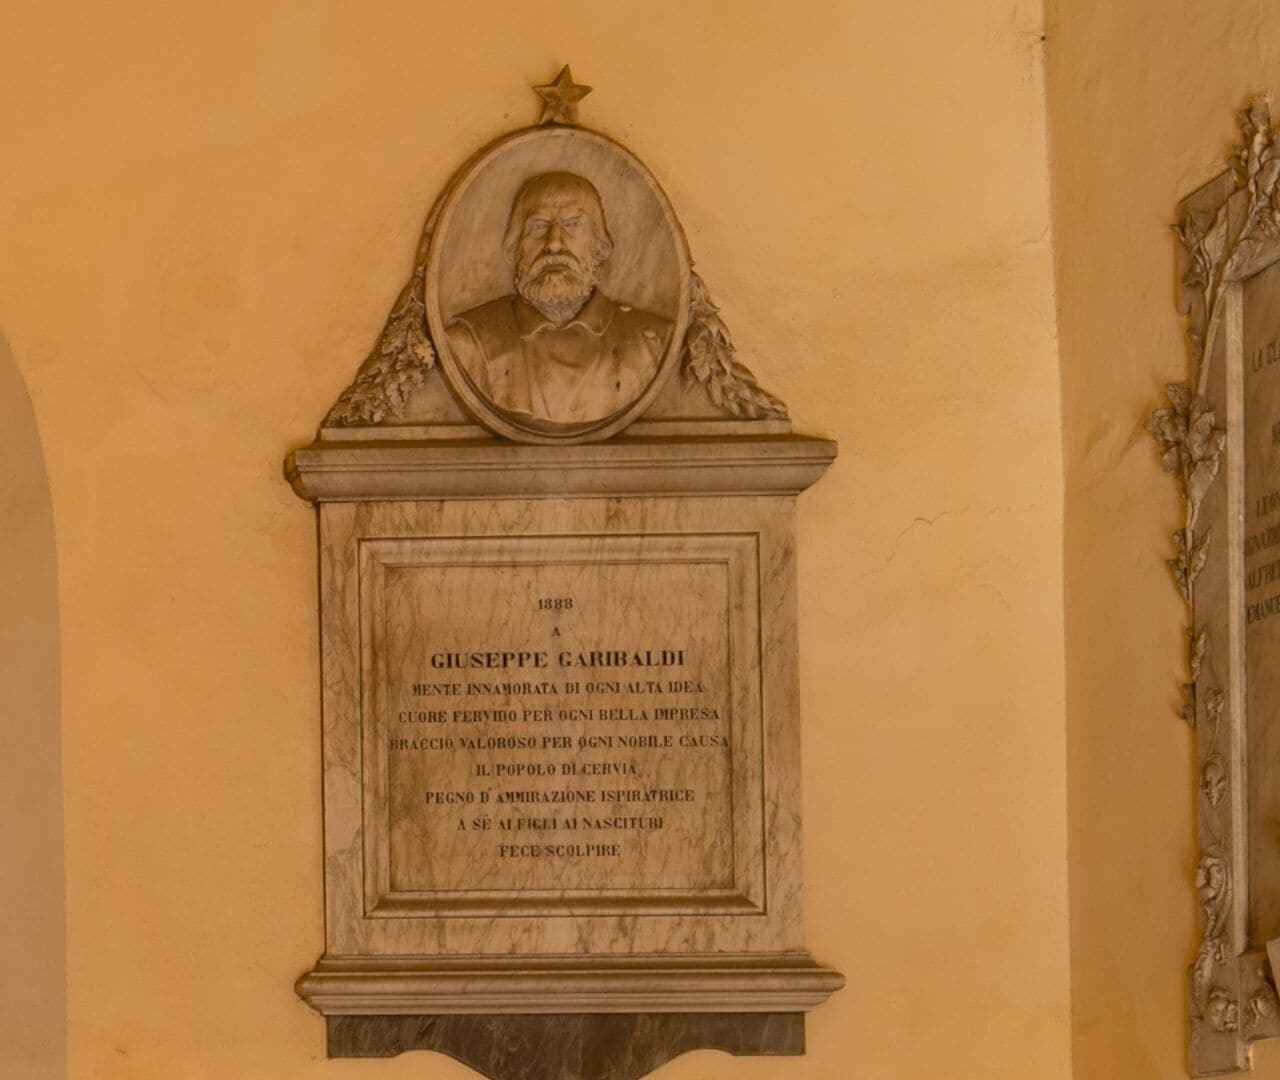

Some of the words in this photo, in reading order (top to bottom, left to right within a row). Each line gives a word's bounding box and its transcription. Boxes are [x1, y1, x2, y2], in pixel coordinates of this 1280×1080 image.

[538, 598, 574, 610] 1888
[551, 627, 561, 637] A
[431, 652, 548, 669] GIUSEPPE
[559, 650, 685, 668] GARIBALDI
[413, 683, 461, 696] MENTE
[468, 682, 558, 696] INNAMORATA
[565, 682, 580, 695] DI
[586, 682, 620, 695] OGNI
[626, 681, 663, 694] ALTA
[669, 681, 704, 693] IDEA
[399, 711, 447, 724] CUORE
[453, 710, 517, 723] FERVIDO
[523, 710, 553, 722] PER
[559, 709, 593, 722] OGNI
[600, 709, 648, 721] BELLA
[654, 708, 720, 720] IMPRESA
[390, 738, 453, 750] BRACCIO
[460, 737, 537, 750] VALOROSO
[542, 736, 573, 749] PER
[579, 736, 613, 749] OGNI
[618, 735, 673, 748] NOBILE
[679, 735, 730, 748] CAUSA
[476, 764, 490, 776] IL
[496, 764, 556, 776] POPOLO
[562, 763, 576, 776] DI
[582, 763, 637, 776] CERVIA
[425, 791, 475, 804] PEGNO
[496, 791, 595, 803] AMMIRAZIONE
[601, 790, 695, 802] ISPIRATRICE
[457, 819, 466, 831] A
[499, 819, 512, 831] AI
[517, 818, 557, 830] FIGLI
[563, 818, 577, 830] AI
[583, 817, 664, 830] NASCITURI
[499, 845, 540, 857] FECE
[545, 844, 621, 857] SCOLPIRE
